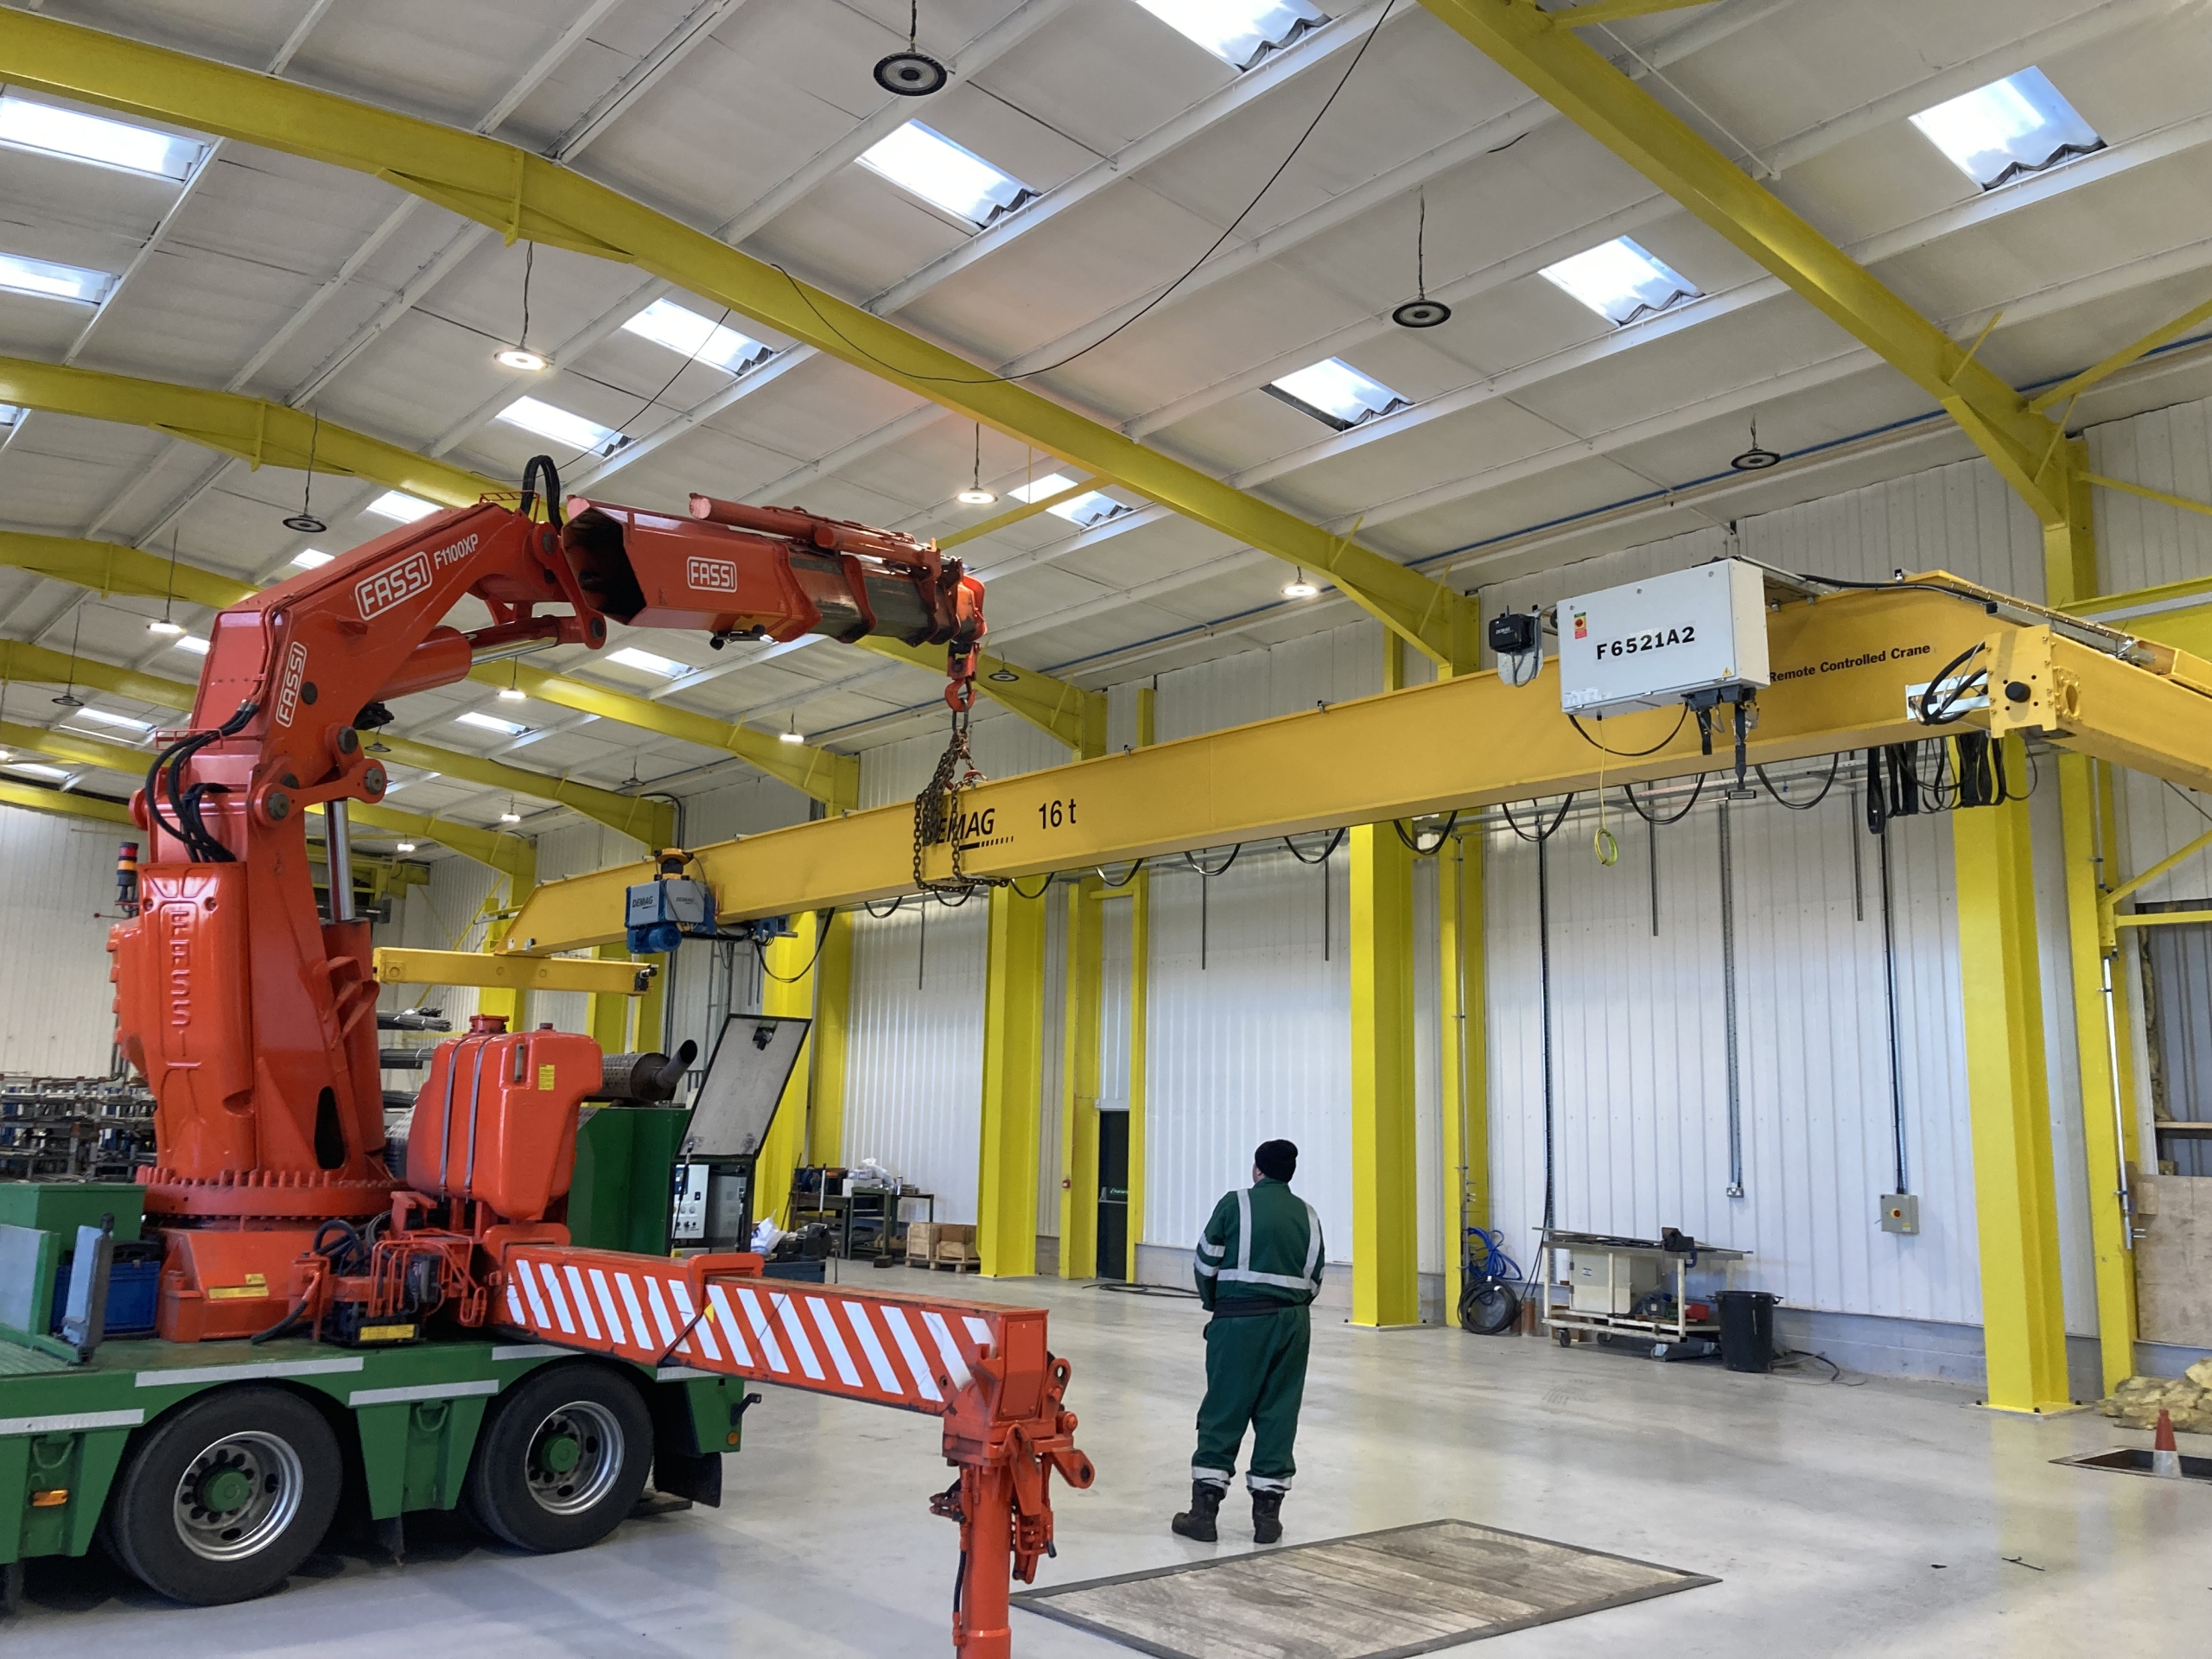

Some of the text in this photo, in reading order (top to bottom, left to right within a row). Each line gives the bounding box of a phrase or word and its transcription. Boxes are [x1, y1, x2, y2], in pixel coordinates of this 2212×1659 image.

[433, 533, 479, 570] F1100XP
[360, 558, 428, 613] FASSI
[690, 562, 734, 588] FASSI
[1596, 626, 1695, 660] F6521A2
[1770, 645, 1930, 683] Remote Controlled Crane
[278, 647, 304, 721] FASSI
[922, 808, 995, 847] EMAG
[1039, 798, 1077, 830] 16 t
[632, 895, 653, 908] DEMAG
[169, 911, 191, 1057] FASSI
